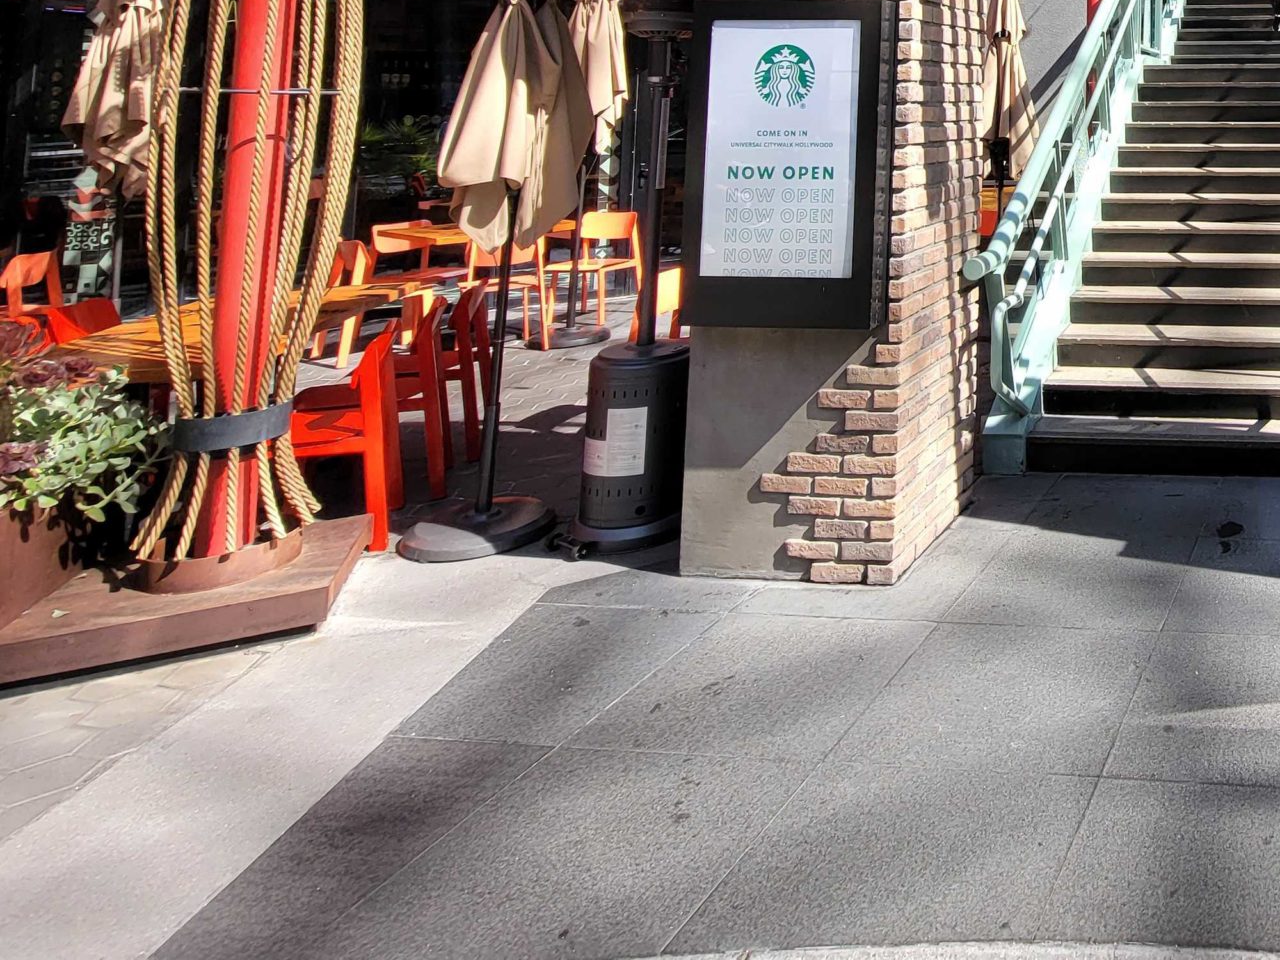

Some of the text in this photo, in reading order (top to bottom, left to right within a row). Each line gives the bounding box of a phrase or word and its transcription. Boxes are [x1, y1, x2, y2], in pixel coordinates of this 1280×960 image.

[728, 166, 834, 180] NOW OPEN
[726, 188, 834, 203] NOW OPEN
[725, 208, 833, 223] NOW OPEN
[724, 228, 833, 243] NOW OPEN
[723, 248, 832, 264] NOW OPEN
